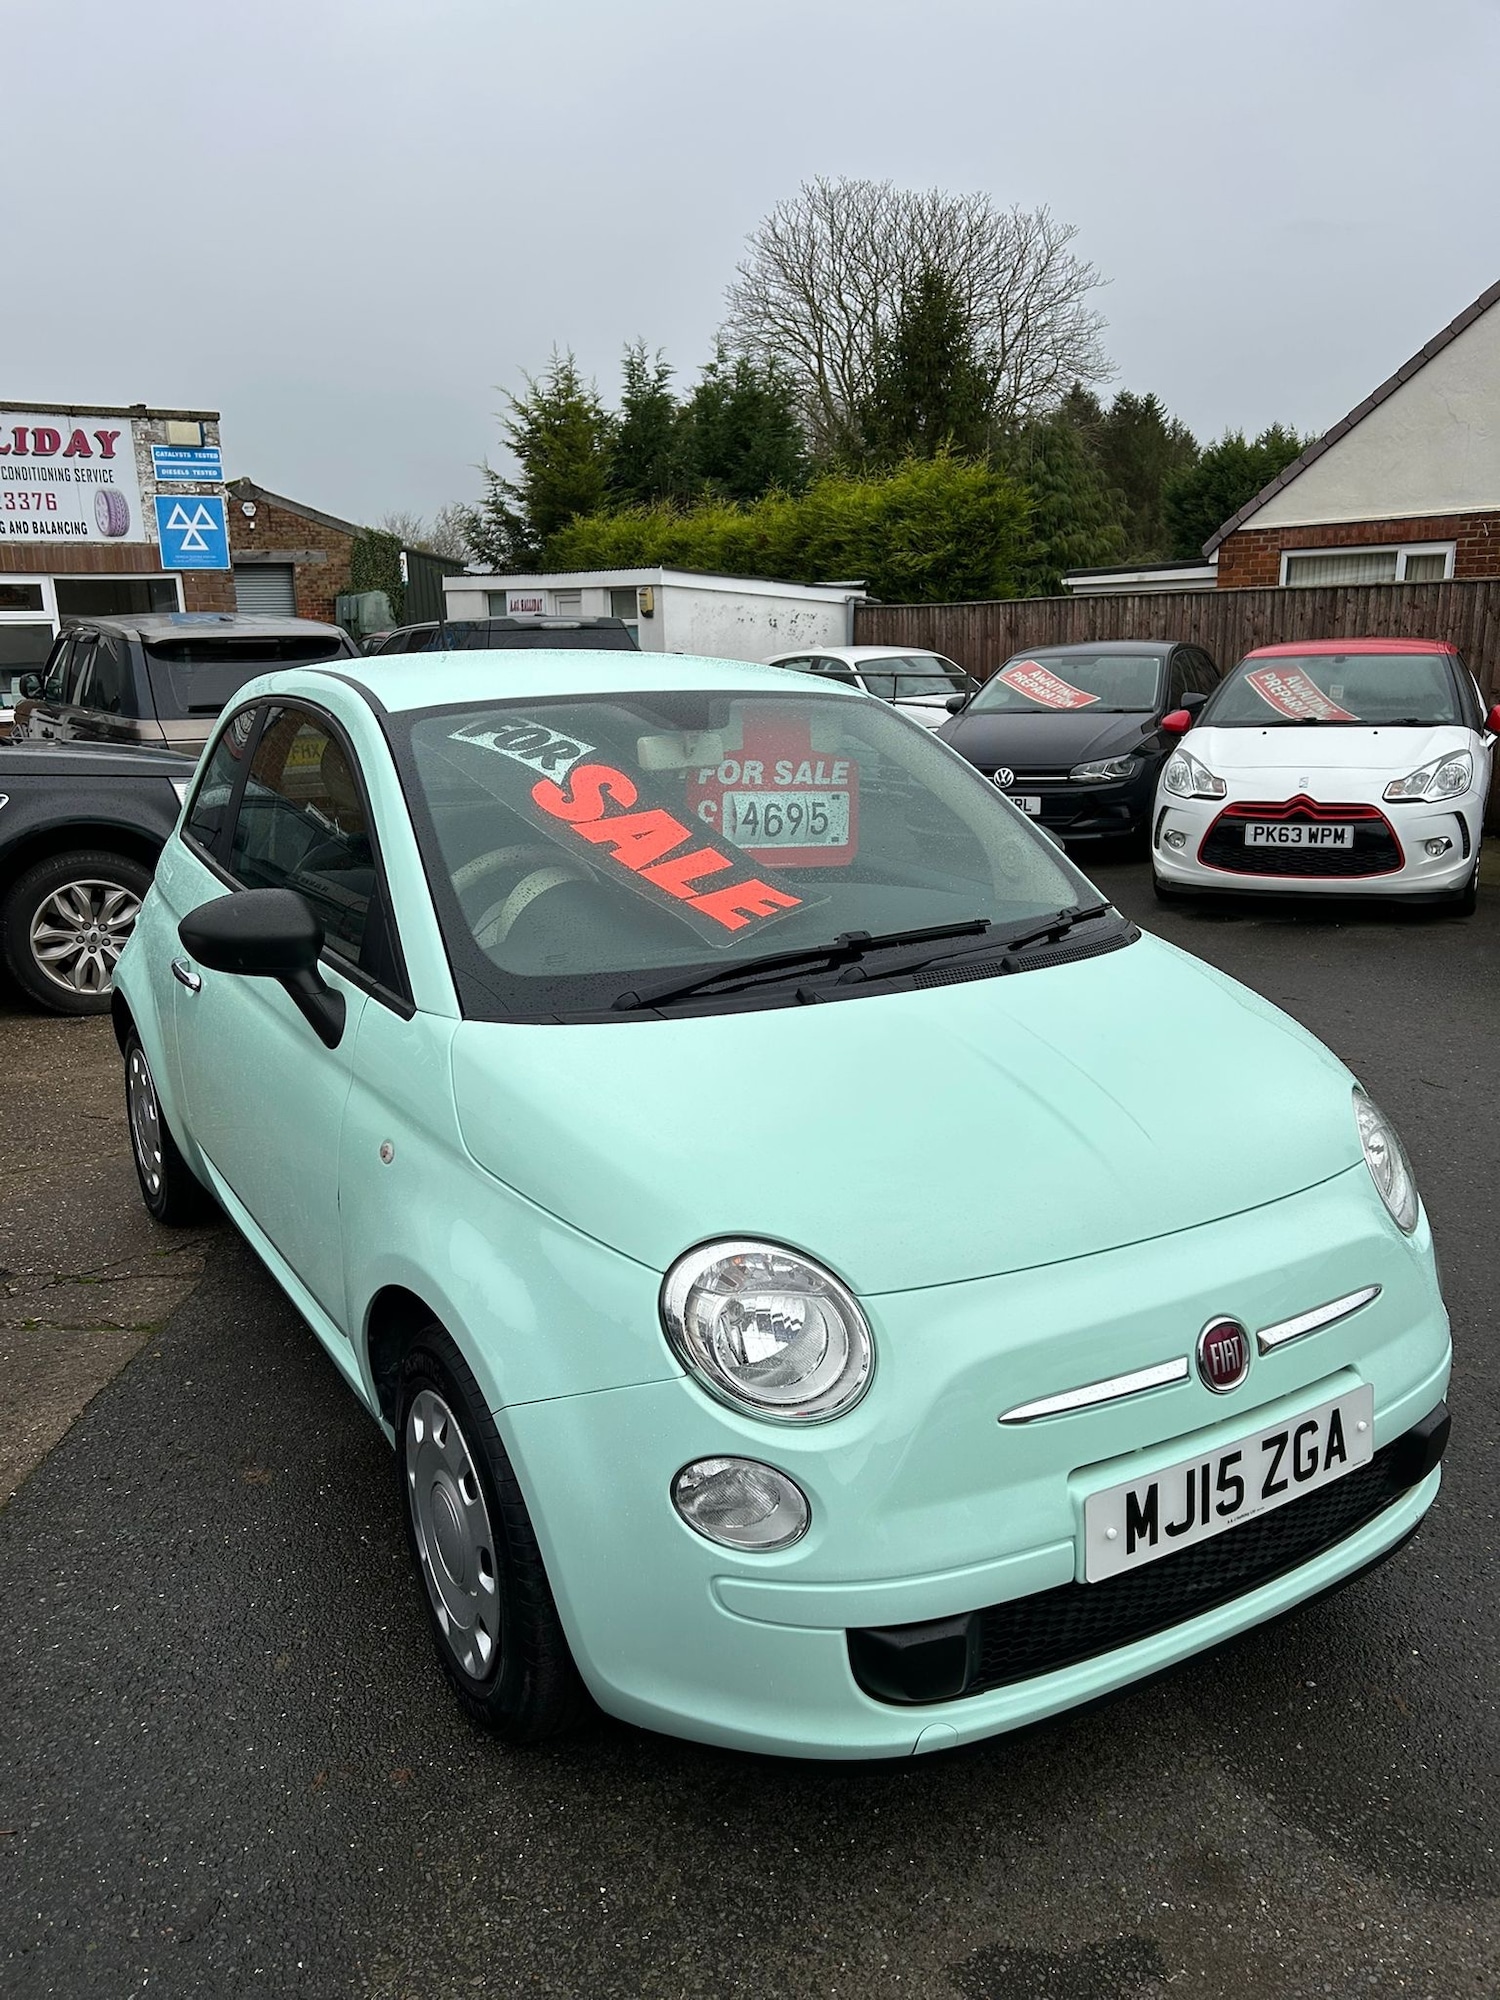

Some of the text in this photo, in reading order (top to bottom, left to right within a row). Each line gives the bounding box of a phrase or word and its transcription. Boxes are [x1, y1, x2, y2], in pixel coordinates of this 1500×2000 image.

[155, 451, 191, 459] CATALYSTS
[1, 466, 115, 483] CONDITIONING SERVICE
[0, 492, 58, 511] 3376
[9, 521, 29, 534] AND
[33, 521, 88, 535] BALANCING
[458, 718, 583, 771] FOR
[698, 759, 850, 785] FOR SALE
[1010, 798, 1032, 812] RL
[741, 801, 829, 837] 4695
[1253, 825, 1346, 844] PK63 WPM
[531, 764, 803, 932] SALE
[1209, 1335, 1240, 1376] FIAT
[1126, 1407, 1348, 1556] MJ15 ZGA
